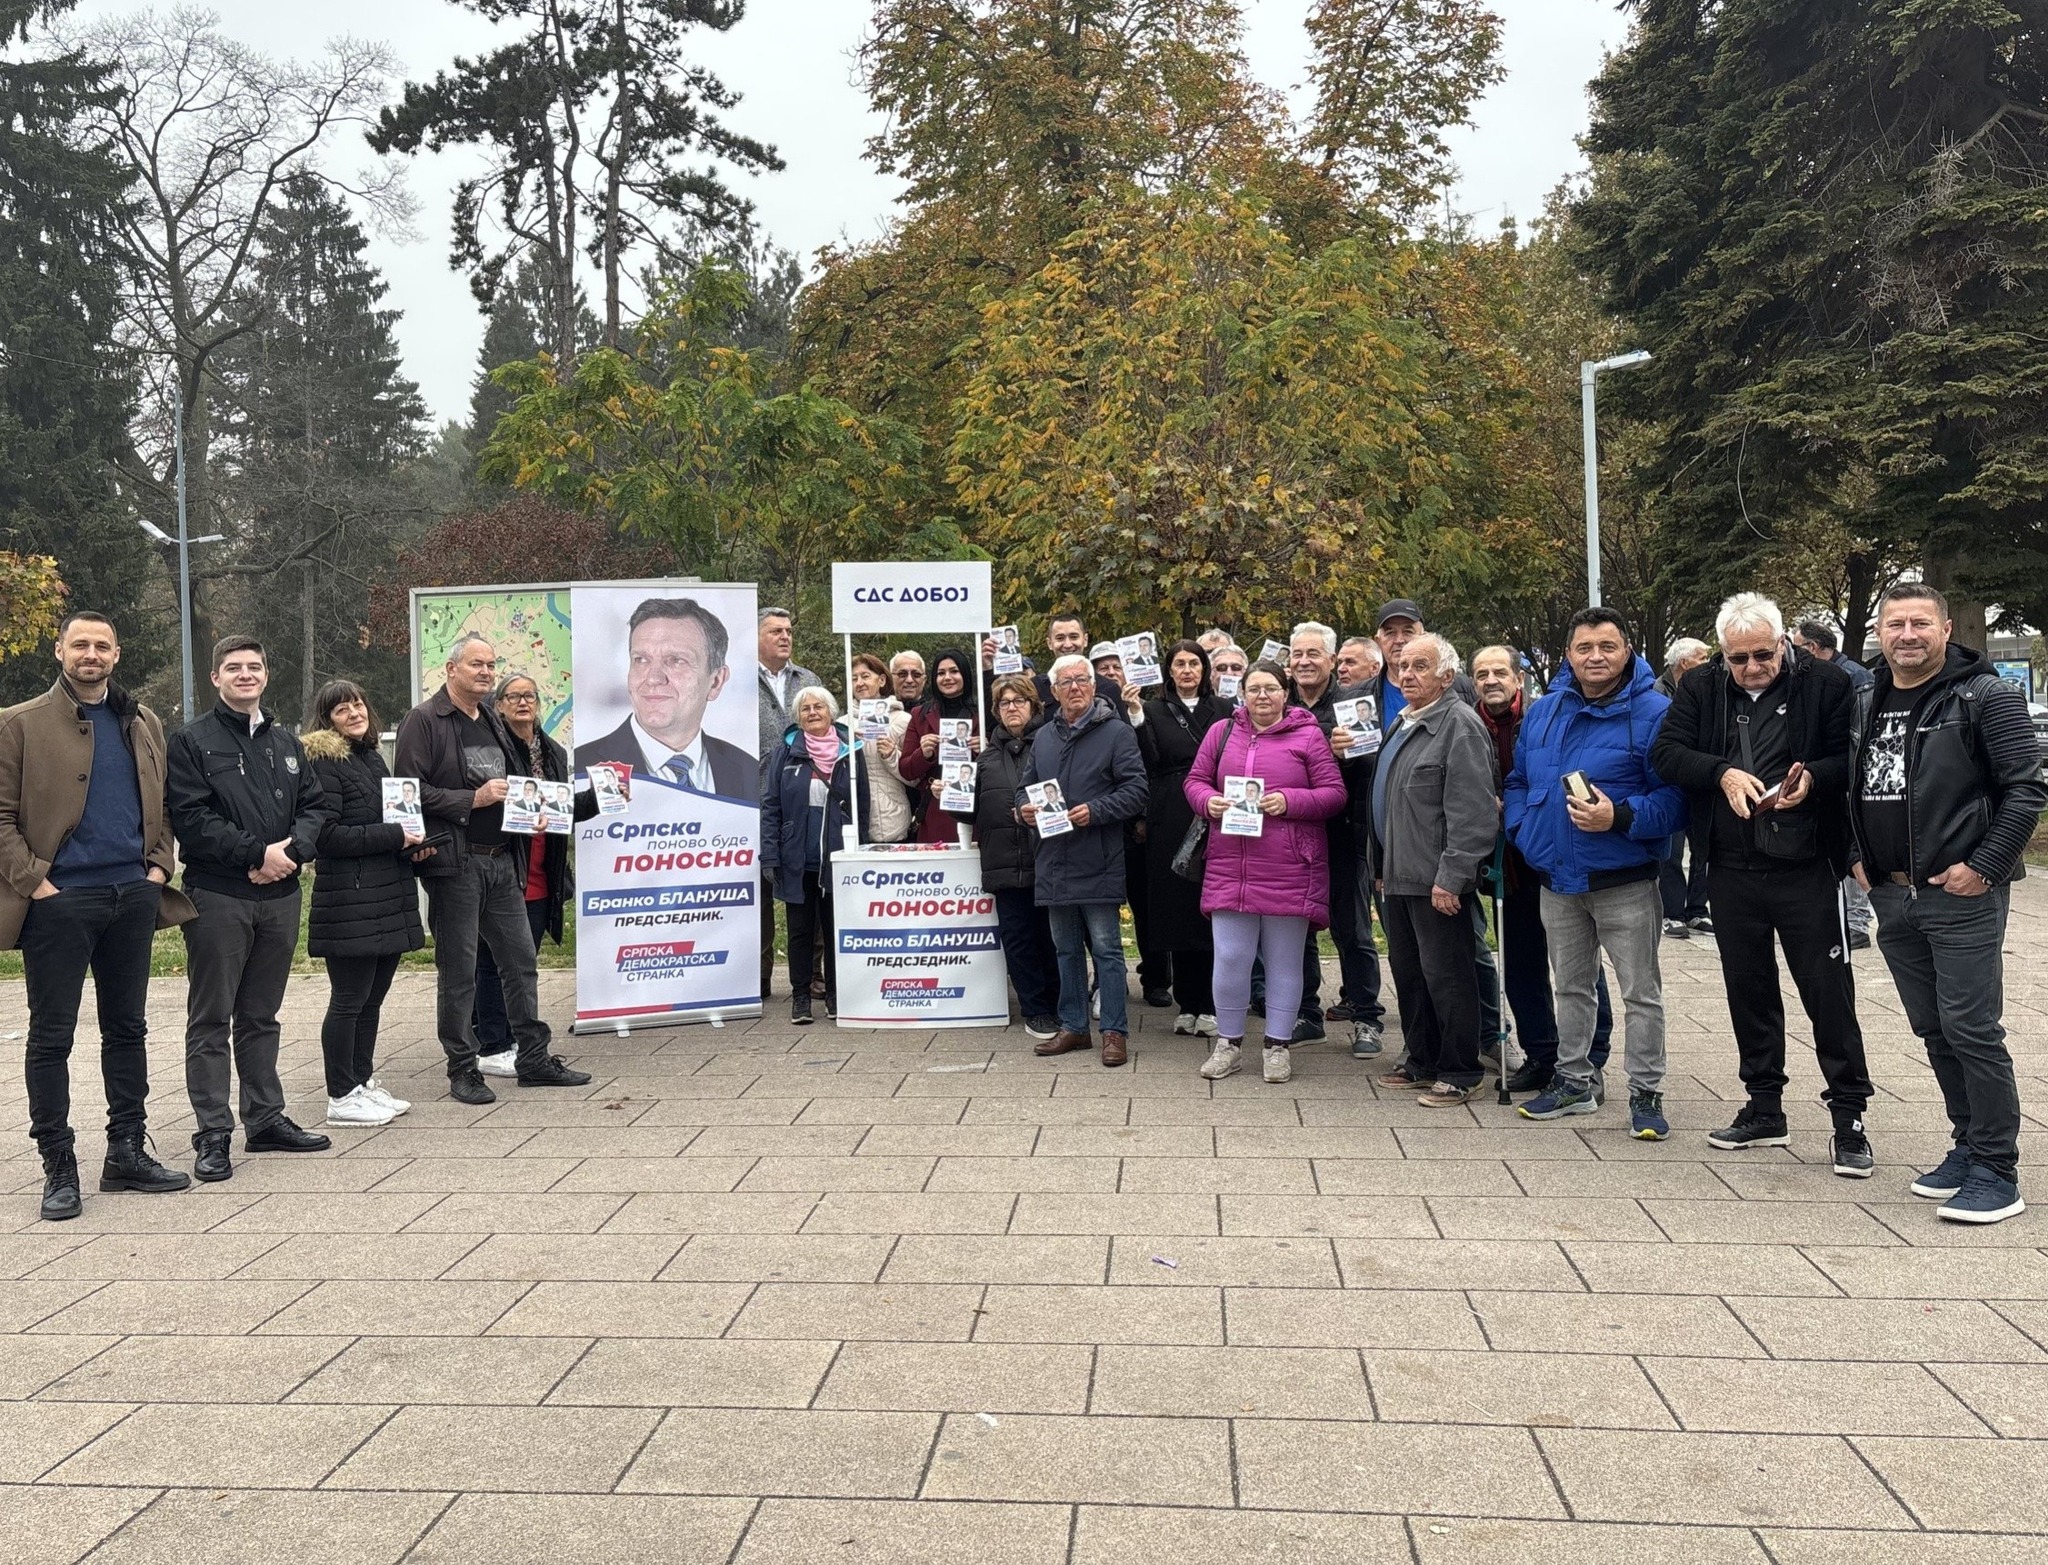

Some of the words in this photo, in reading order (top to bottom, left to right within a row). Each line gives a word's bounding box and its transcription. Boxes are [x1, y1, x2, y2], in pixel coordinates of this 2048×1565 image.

[582, 828, 604, 841] да
[607, 821, 702, 843] Српска
[647, 838, 707, 850] поново
[711, 834, 749, 849] буде
[613, 849, 754, 874] поносна
[842, 874, 859, 886] да
[861, 869, 945, 889] Српска
[896, 886, 950, 897] поново
[587, 895, 655, 912] Бранко
[658, 888, 750, 906] БЛАНУША
[868, 897, 994, 917] поносна
[614, 910, 724, 927] ПРЕДСЈЕДНИК.
[843, 935, 903, 950] Бранко
[907, 932, 996, 947] БЛАНУША
[622, 944, 675, 959] СРПСКА
[621, 953, 716, 972] ДЕМОКРАТСКА
[866, 955, 972, 968] ПРЕДСЈЕДНИК.
[626, 968, 685, 982] СТРАНКА
[884, 980, 924, 989] СРПСКА
[884, 988, 956, 999] ДЕМОКРАТСКА
[888, 999, 932, 1008] СТРАНКА
